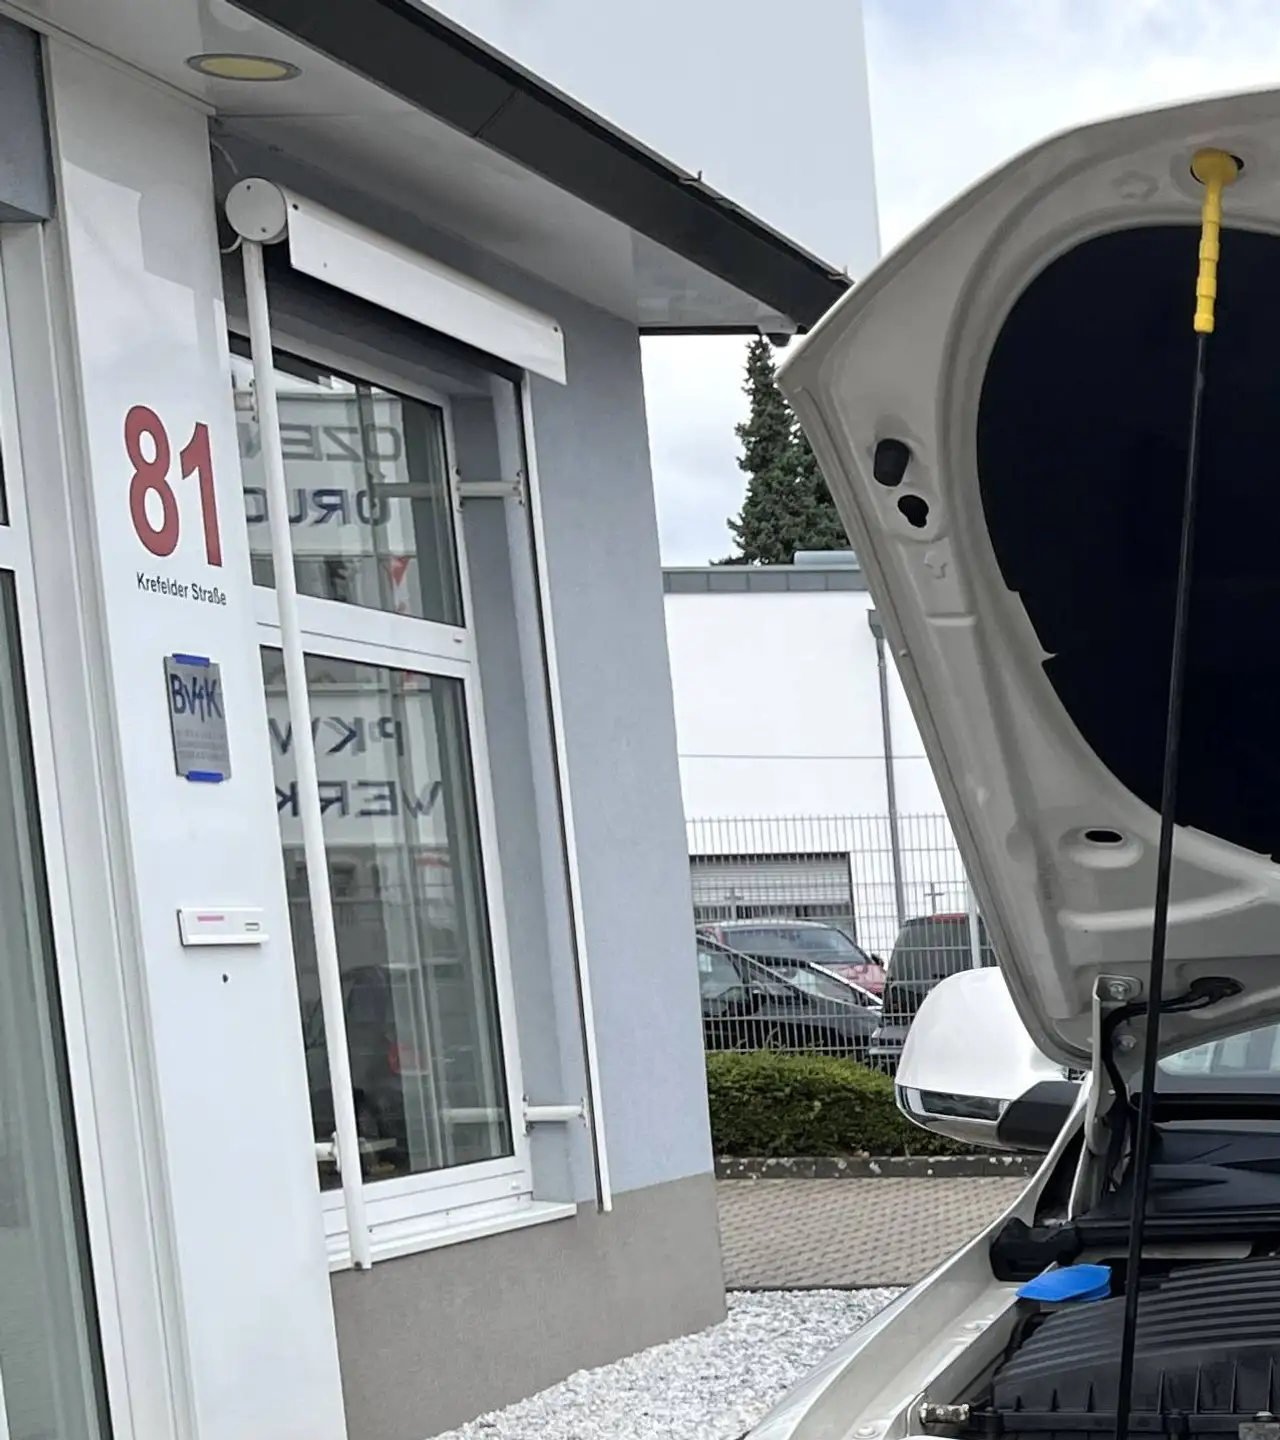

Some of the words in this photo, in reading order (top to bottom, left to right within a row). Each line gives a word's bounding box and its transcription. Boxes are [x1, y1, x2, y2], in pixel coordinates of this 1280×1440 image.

[124, 404, 223, 567] 81
[136, 571, 188, 599] Krefelder
[191, 582, 227, 606] Straße
